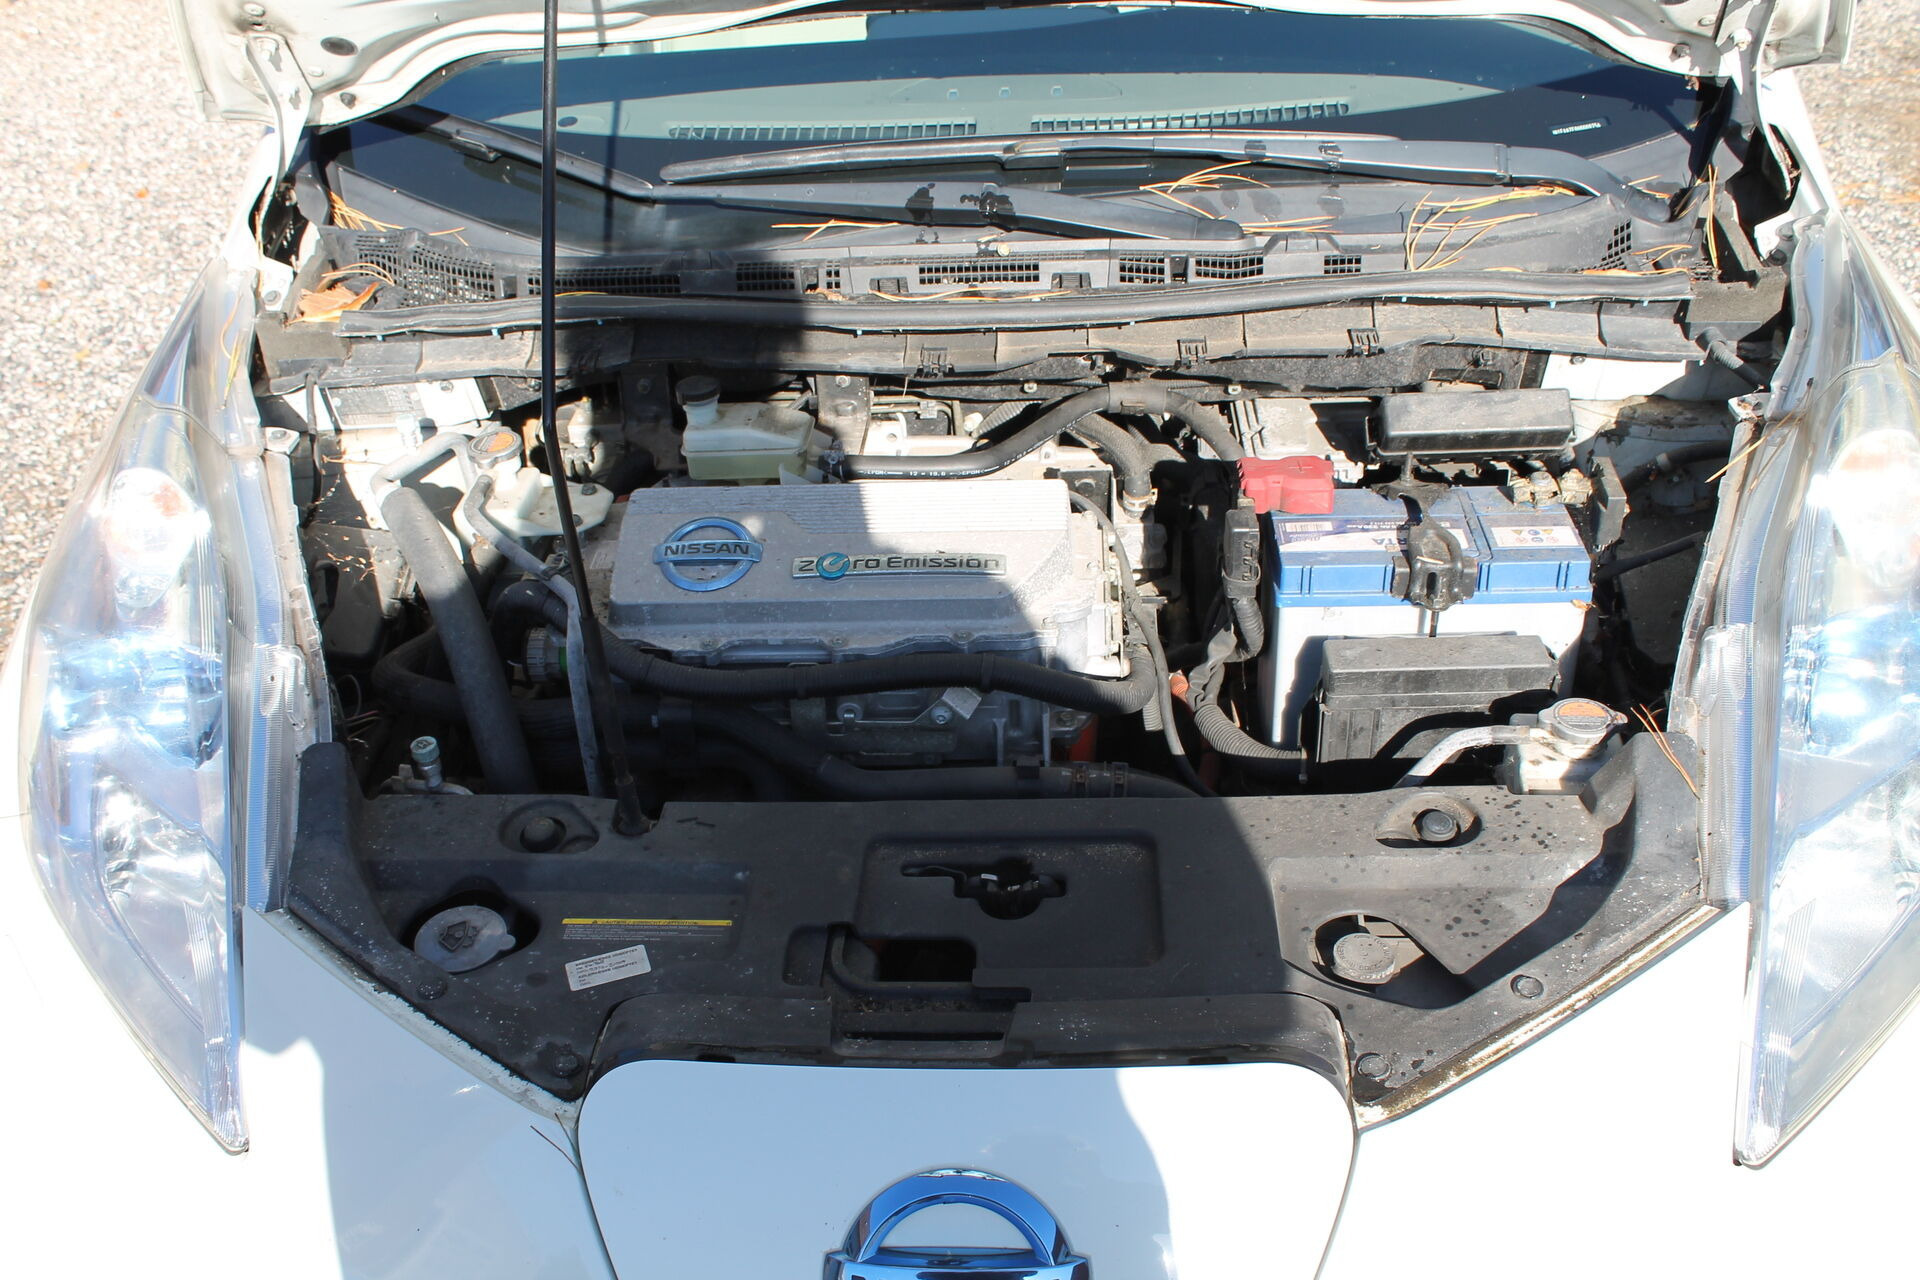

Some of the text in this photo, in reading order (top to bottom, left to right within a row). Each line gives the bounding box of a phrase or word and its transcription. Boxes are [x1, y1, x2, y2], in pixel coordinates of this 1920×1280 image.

[1371, 537, 1409, 546] RTA
[664, 543, 750, 557] NISSAN
[798, 552, 1000, 580] zero Emission
